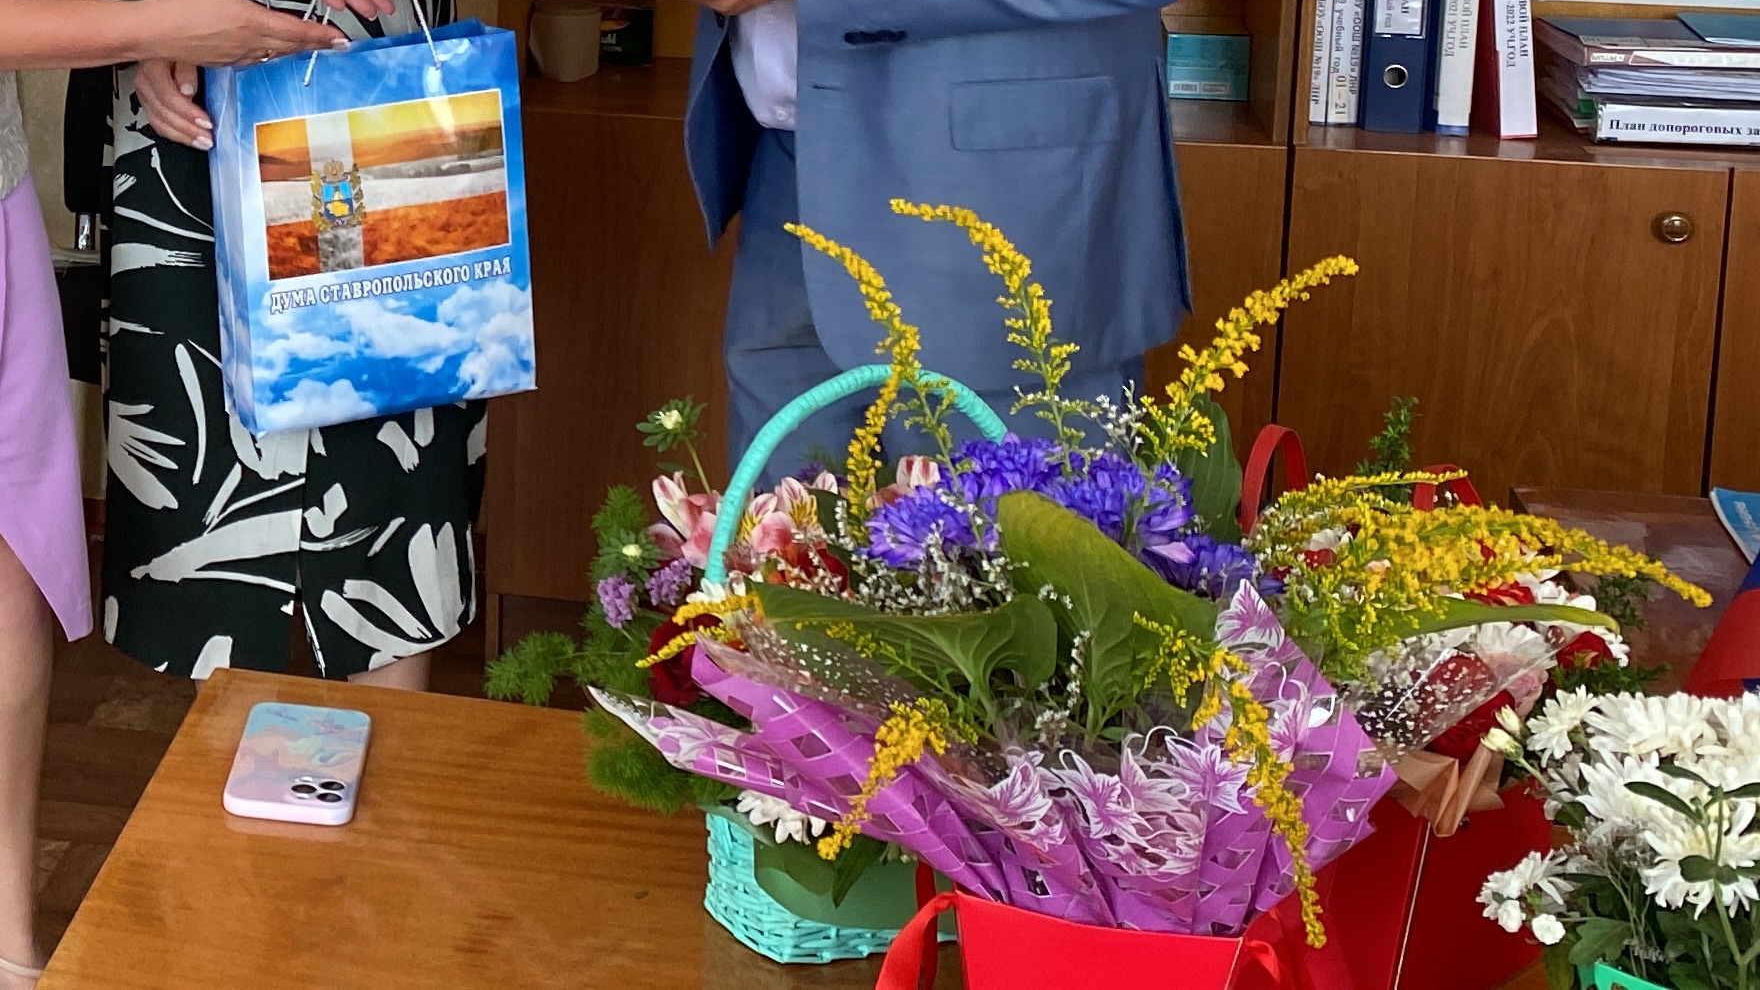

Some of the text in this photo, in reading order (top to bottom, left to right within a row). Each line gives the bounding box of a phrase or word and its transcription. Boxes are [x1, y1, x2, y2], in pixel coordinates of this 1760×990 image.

[1333, 9, 1345, 52] учебный
[1443, 20, 1457, 57] УЧ.ГОД
[1459, 19, 1470, 49] ПЛАН
[1518, 26, 1528, 57] ПЛАН
[1506, 27, 1516, 68] УЧ.ГОД
[1330, 56, 1342, 74] год
[1335, 75, 1347, 89] 01
[1334, 102, 1346, 116] 21
[1609, 119, 1646, 131] План
[1648, 122, 1742, 136] допороговых
[270, 256, 512, 315] ДУМА СТАВРОПОЛЬСКОГО КРАЯ
